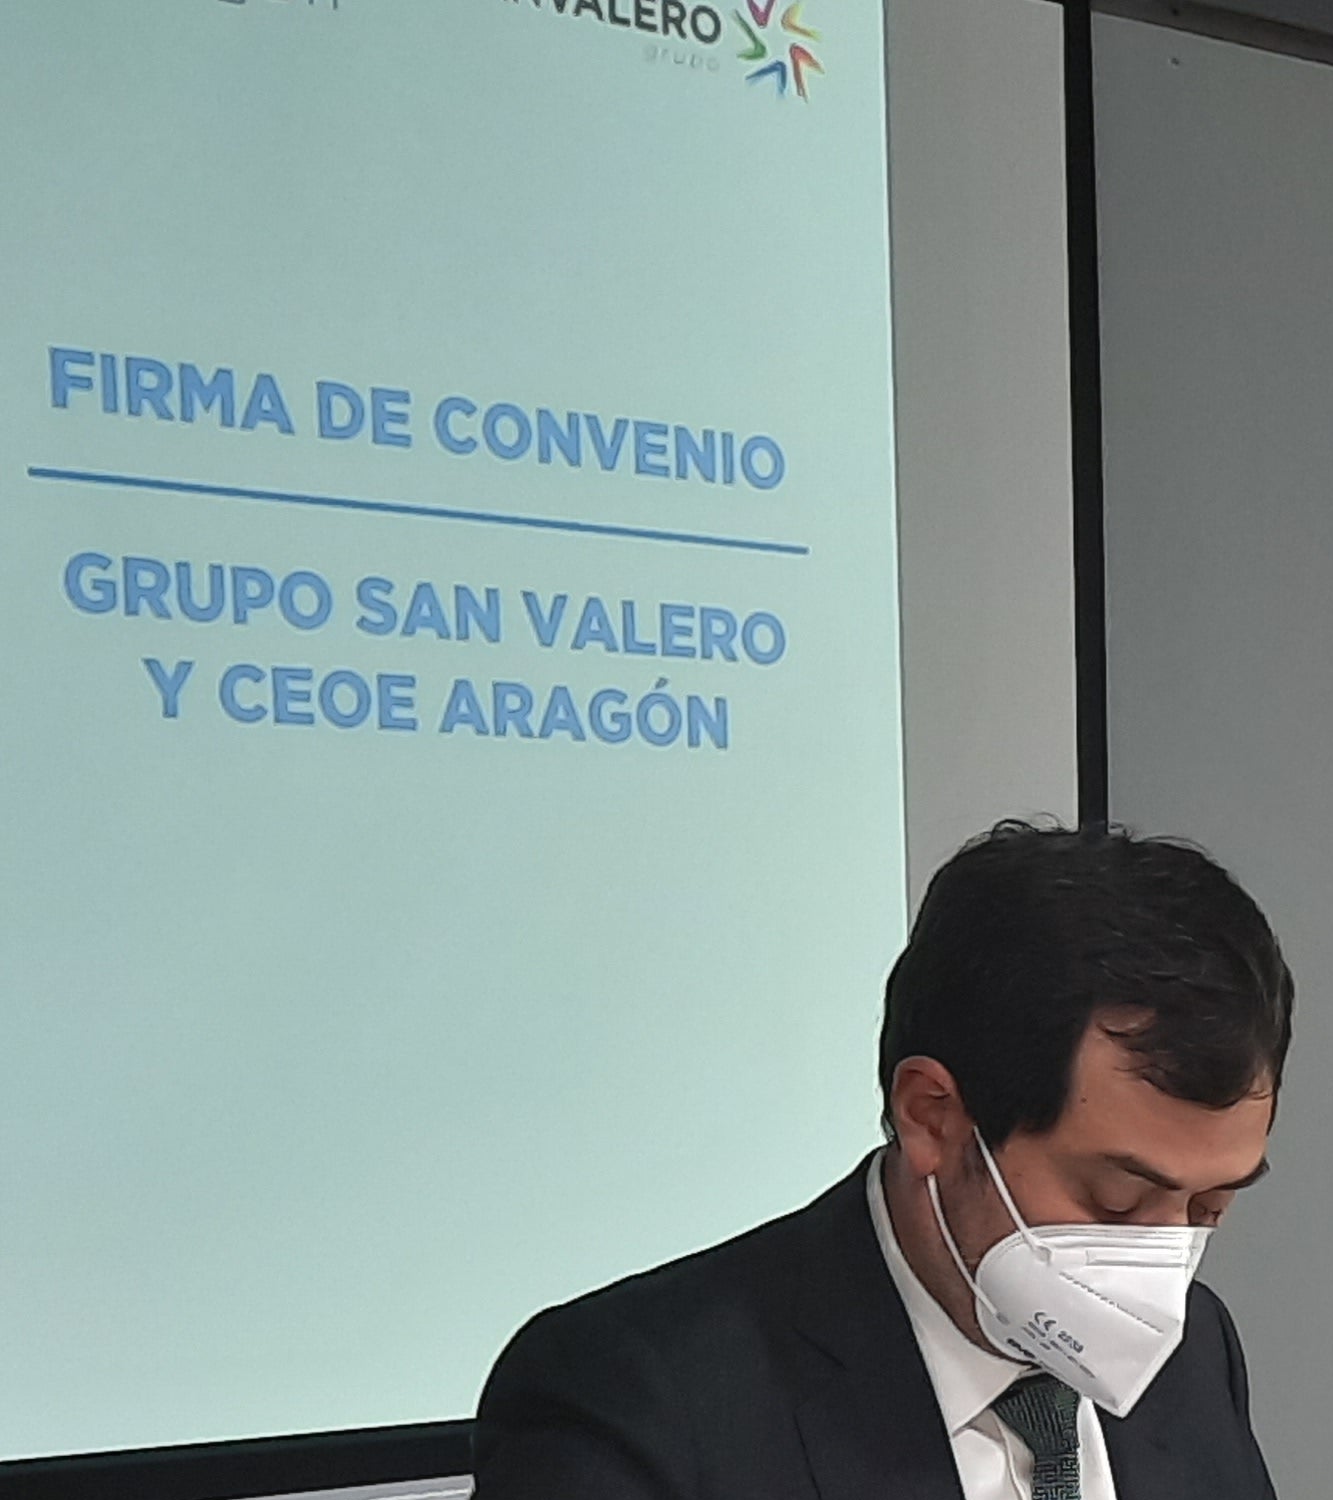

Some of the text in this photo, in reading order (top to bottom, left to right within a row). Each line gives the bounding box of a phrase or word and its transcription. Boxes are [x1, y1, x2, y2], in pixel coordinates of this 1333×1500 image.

[47, 346, 786, 490] FIRMA DE CONVENIO
[63, 552, 787, 665] GRUPO SAN VALERO
[143, 658, 730, 750] Y CEOE ARAGÓN
